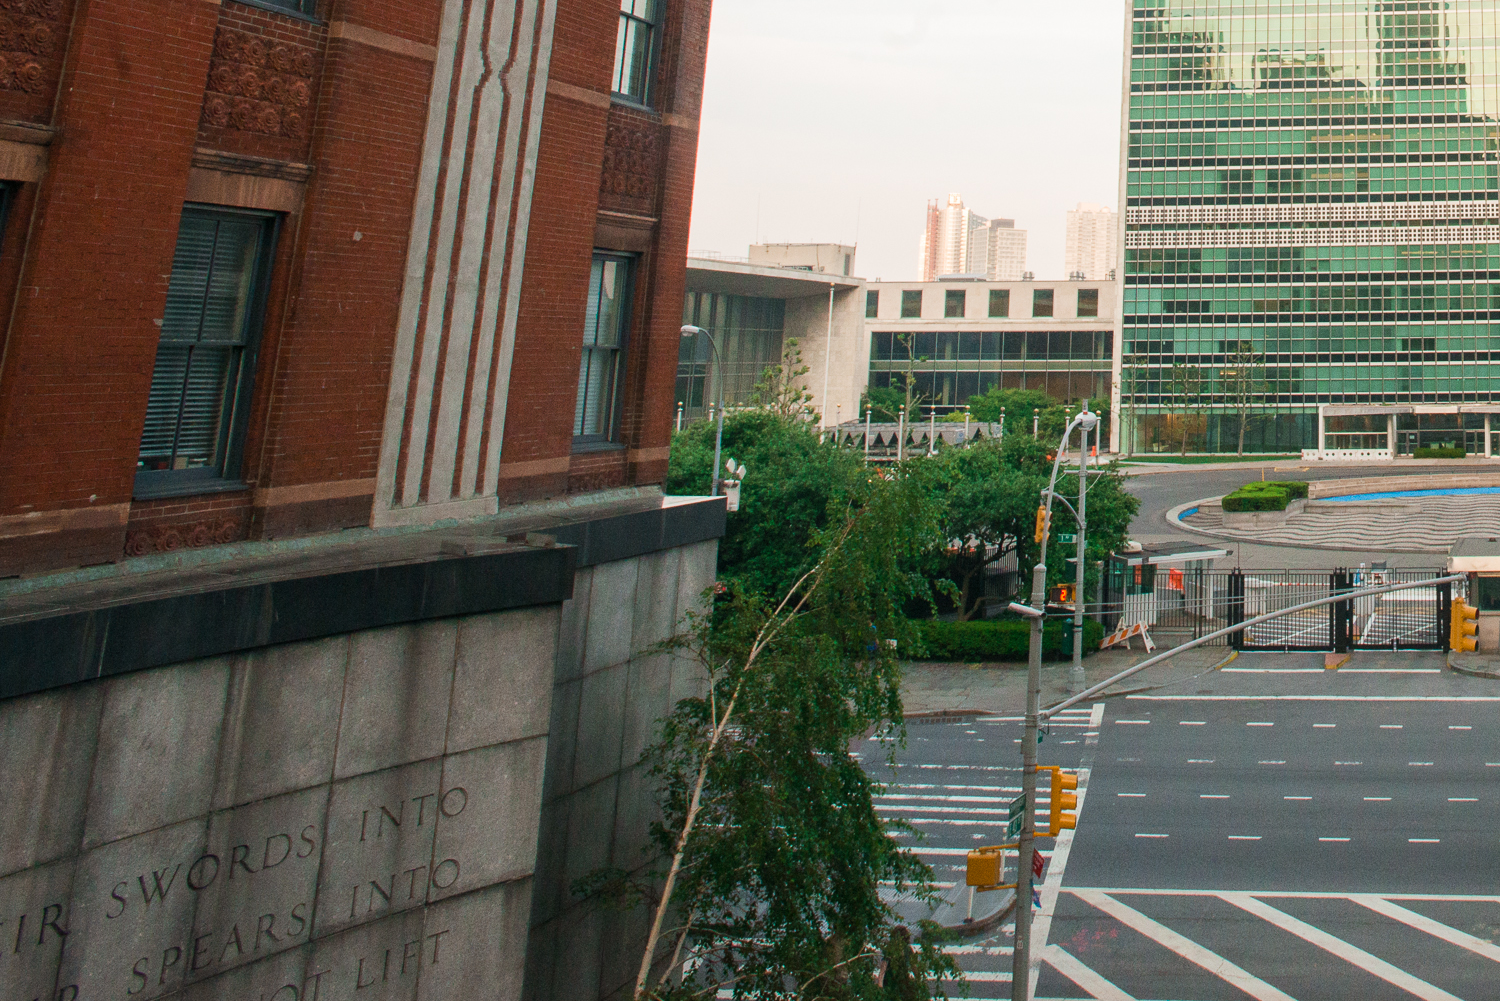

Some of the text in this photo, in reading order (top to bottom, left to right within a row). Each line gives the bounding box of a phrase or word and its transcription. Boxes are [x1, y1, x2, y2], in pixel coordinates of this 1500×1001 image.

[1060, 589, 1067, 601] 2
[0, 786, 469, 954] IR SWORDS INTO
[127, 858, 460, 995] SPEARS INTO
[356, 929, 450, 990] LIFT
